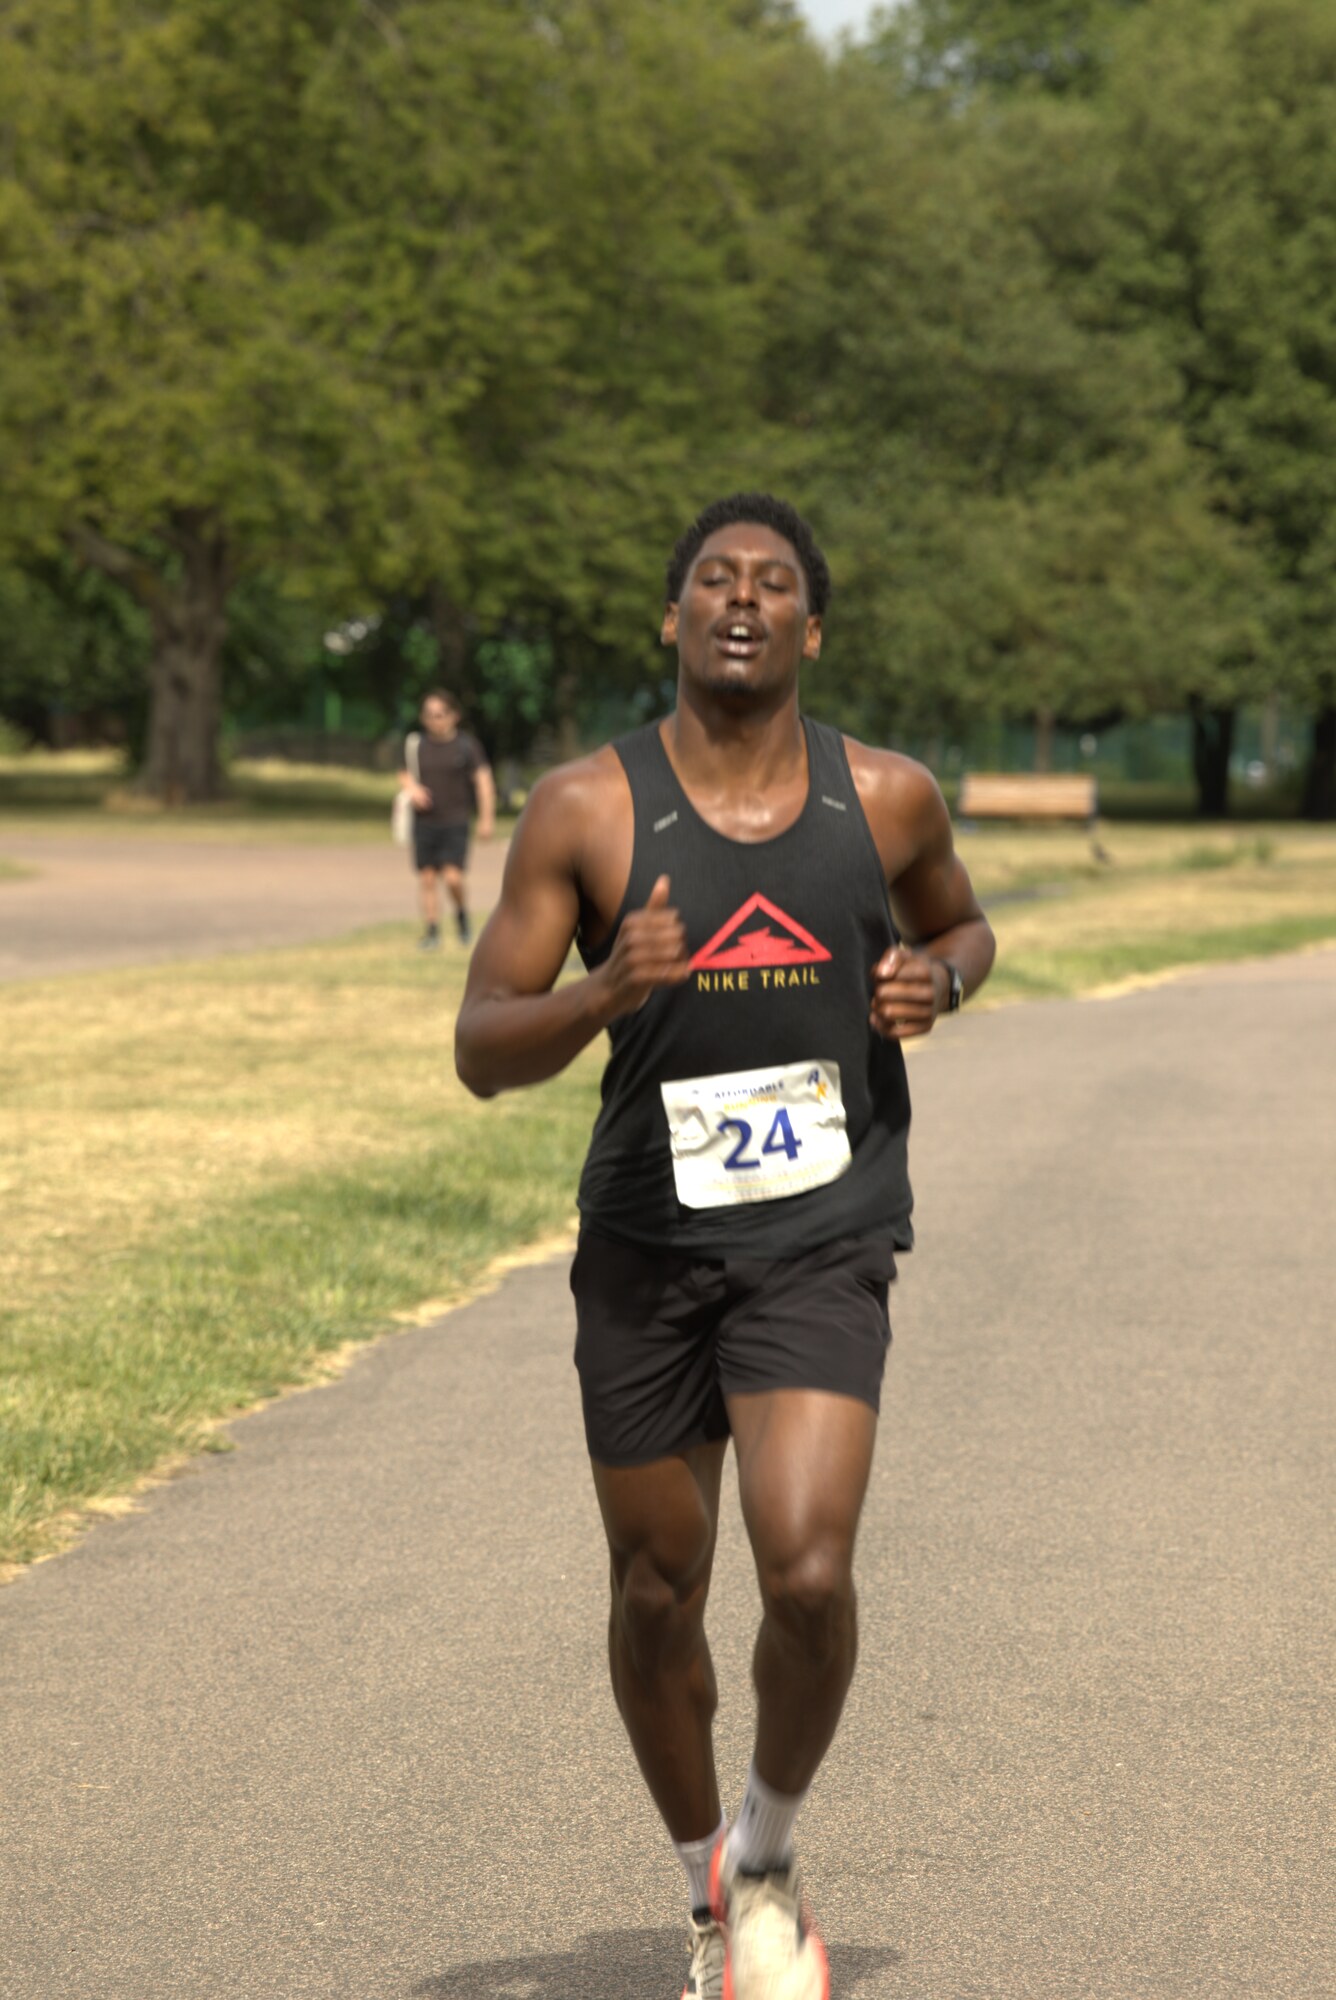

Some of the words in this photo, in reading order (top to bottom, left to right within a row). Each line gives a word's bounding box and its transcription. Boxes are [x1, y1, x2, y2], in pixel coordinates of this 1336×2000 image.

[697, 970, 749, 992] NIKE
[760, 966, 820, 989] TRAIL
[717, 1106, 802, 1171] 24
